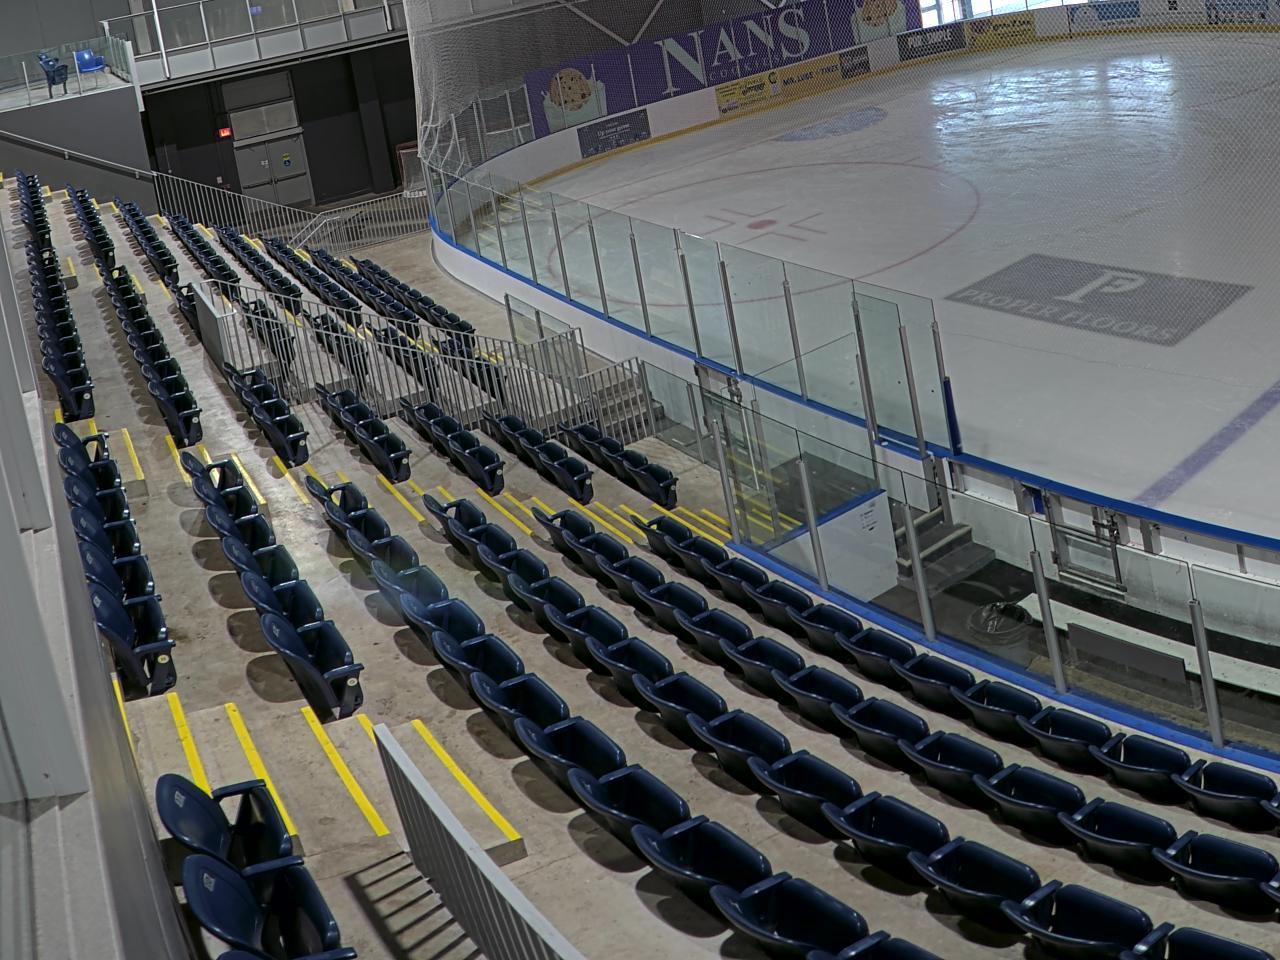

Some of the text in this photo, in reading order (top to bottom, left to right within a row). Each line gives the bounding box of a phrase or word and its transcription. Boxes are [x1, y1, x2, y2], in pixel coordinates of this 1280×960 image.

[654, 7, 812, 97] NANS
[1053, 270, 1149, 304] P
[956, 288, 1178, 342] PROPER FLOORS
